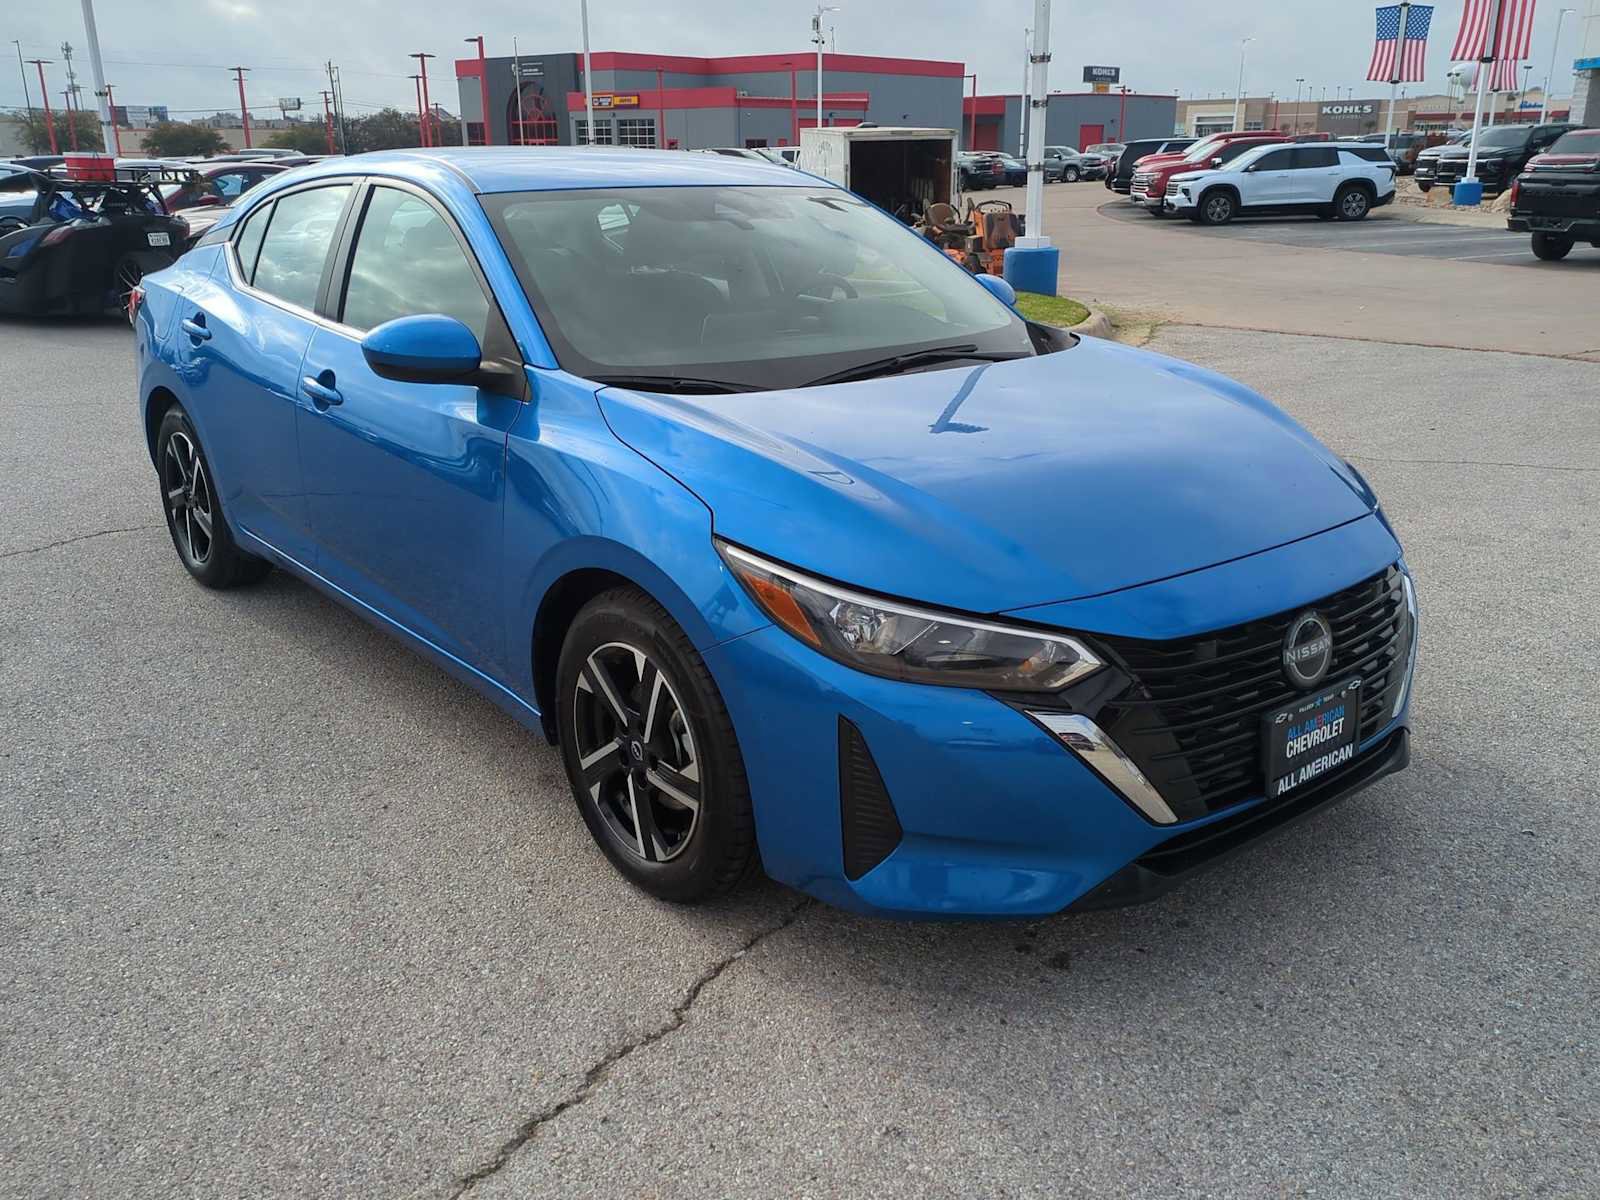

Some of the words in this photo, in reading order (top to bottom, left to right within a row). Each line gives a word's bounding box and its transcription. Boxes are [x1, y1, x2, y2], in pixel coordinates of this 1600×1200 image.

[1322, 105, 1372, 114] KOHL'S
[1286, 635, 1330, 664] NISSAN
[1286, 717, 1345, 758] CHEVROLET
[1287, 724, 1302, 740] ALL
[1304, 705, 1345, 733] AMERICAN
[1277, 773, 1297, 795] ALL
[1298, 743, 1353, 784] AMERICAN
